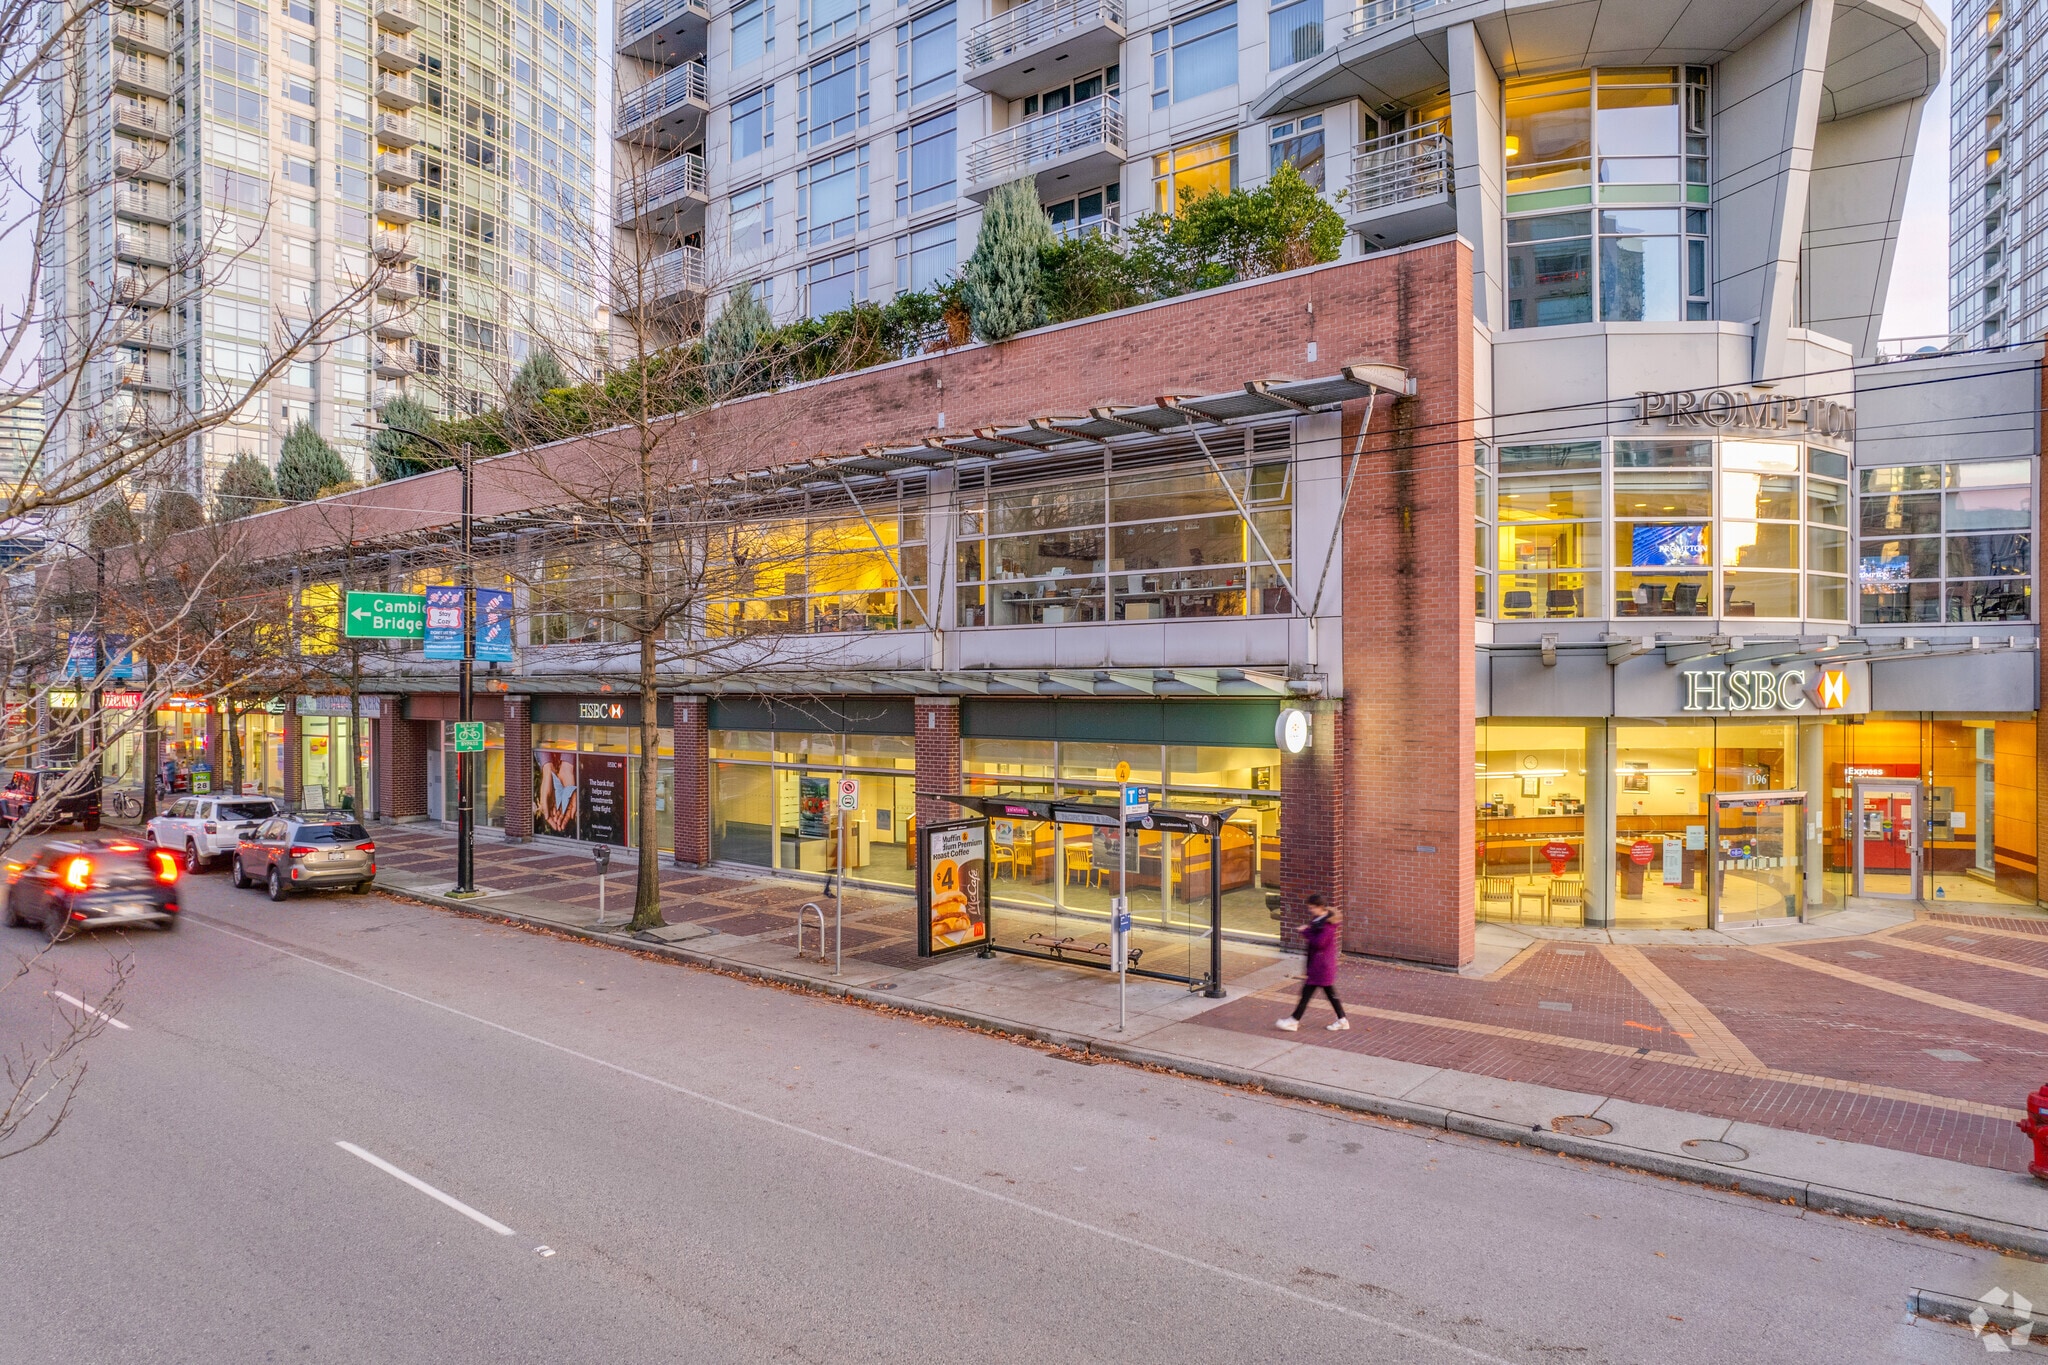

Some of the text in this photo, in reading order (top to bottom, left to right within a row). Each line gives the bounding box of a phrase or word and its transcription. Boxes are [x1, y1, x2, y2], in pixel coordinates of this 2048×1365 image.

[1635, 390, 1856, 442] PROMPTON
[1658, 544, 1708, 553] PROMPTON
[373, 599, 427, 614] Cambie
[373, 616, 424, 634] Bridge
[1684, 669, 1806, 711] HSBC
[579, 703, 608, 719] HSBC
[1120, 769, 1125, 780] 4
[1848, 767, 1883, 776] Express
[1747, 774, 1767, 785] 1196
[1127, 789, 1136, 804] T
[942, 832, 968, 843] Muffin &
[958, 839, 982, 849] Premium
[950, 849, 970, 857] Coffee
[936, 867, 954, 890] $4
